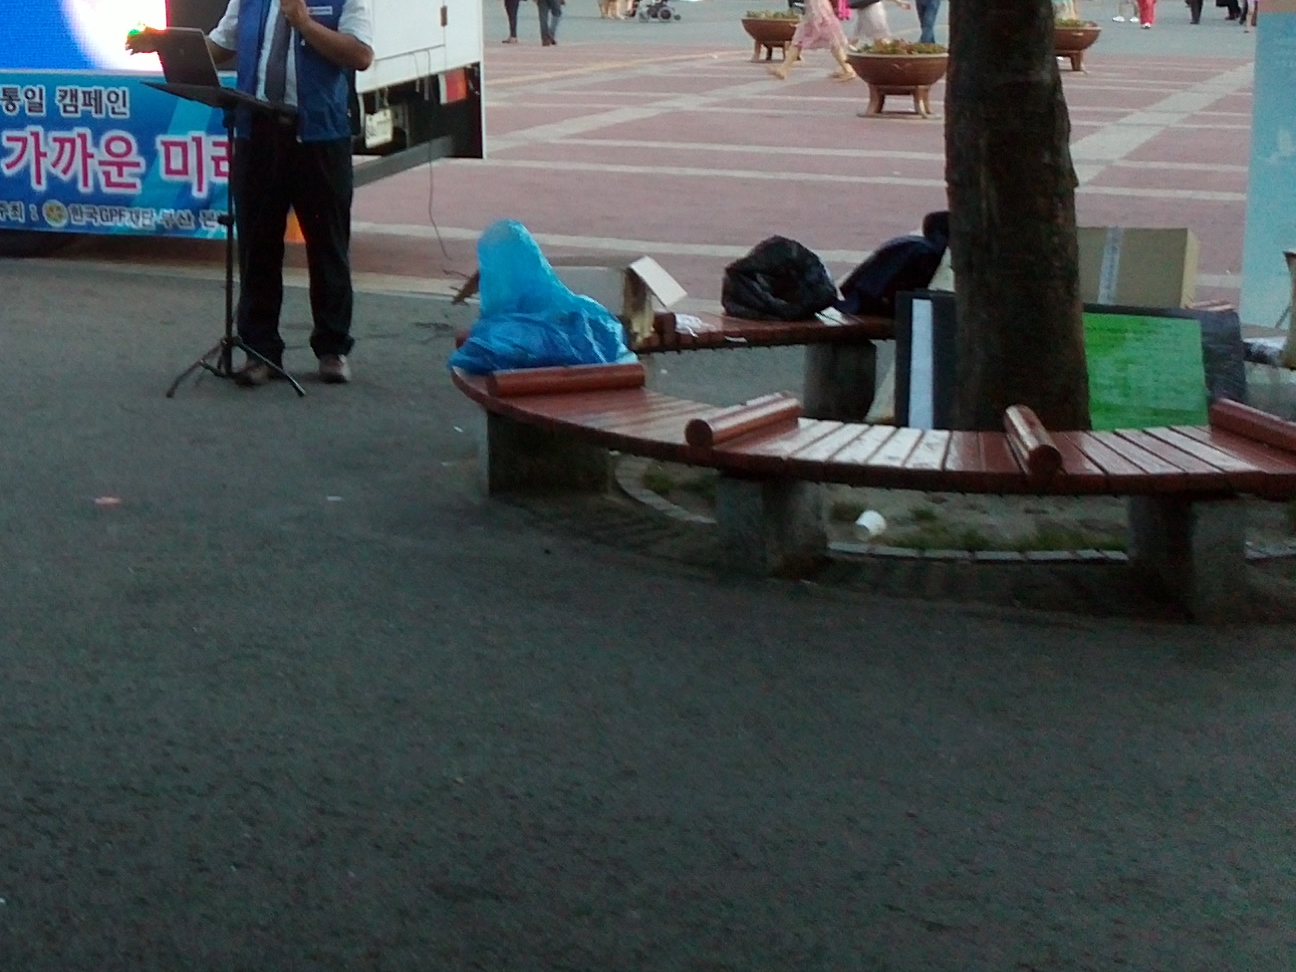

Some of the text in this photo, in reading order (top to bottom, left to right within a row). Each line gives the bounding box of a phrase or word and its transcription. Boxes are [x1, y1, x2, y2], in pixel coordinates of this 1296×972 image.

[0, 85, 44, 116] 통일
[58, 88, 129, 118] 캠페인
[3, 126, 143, 194] 가까운
